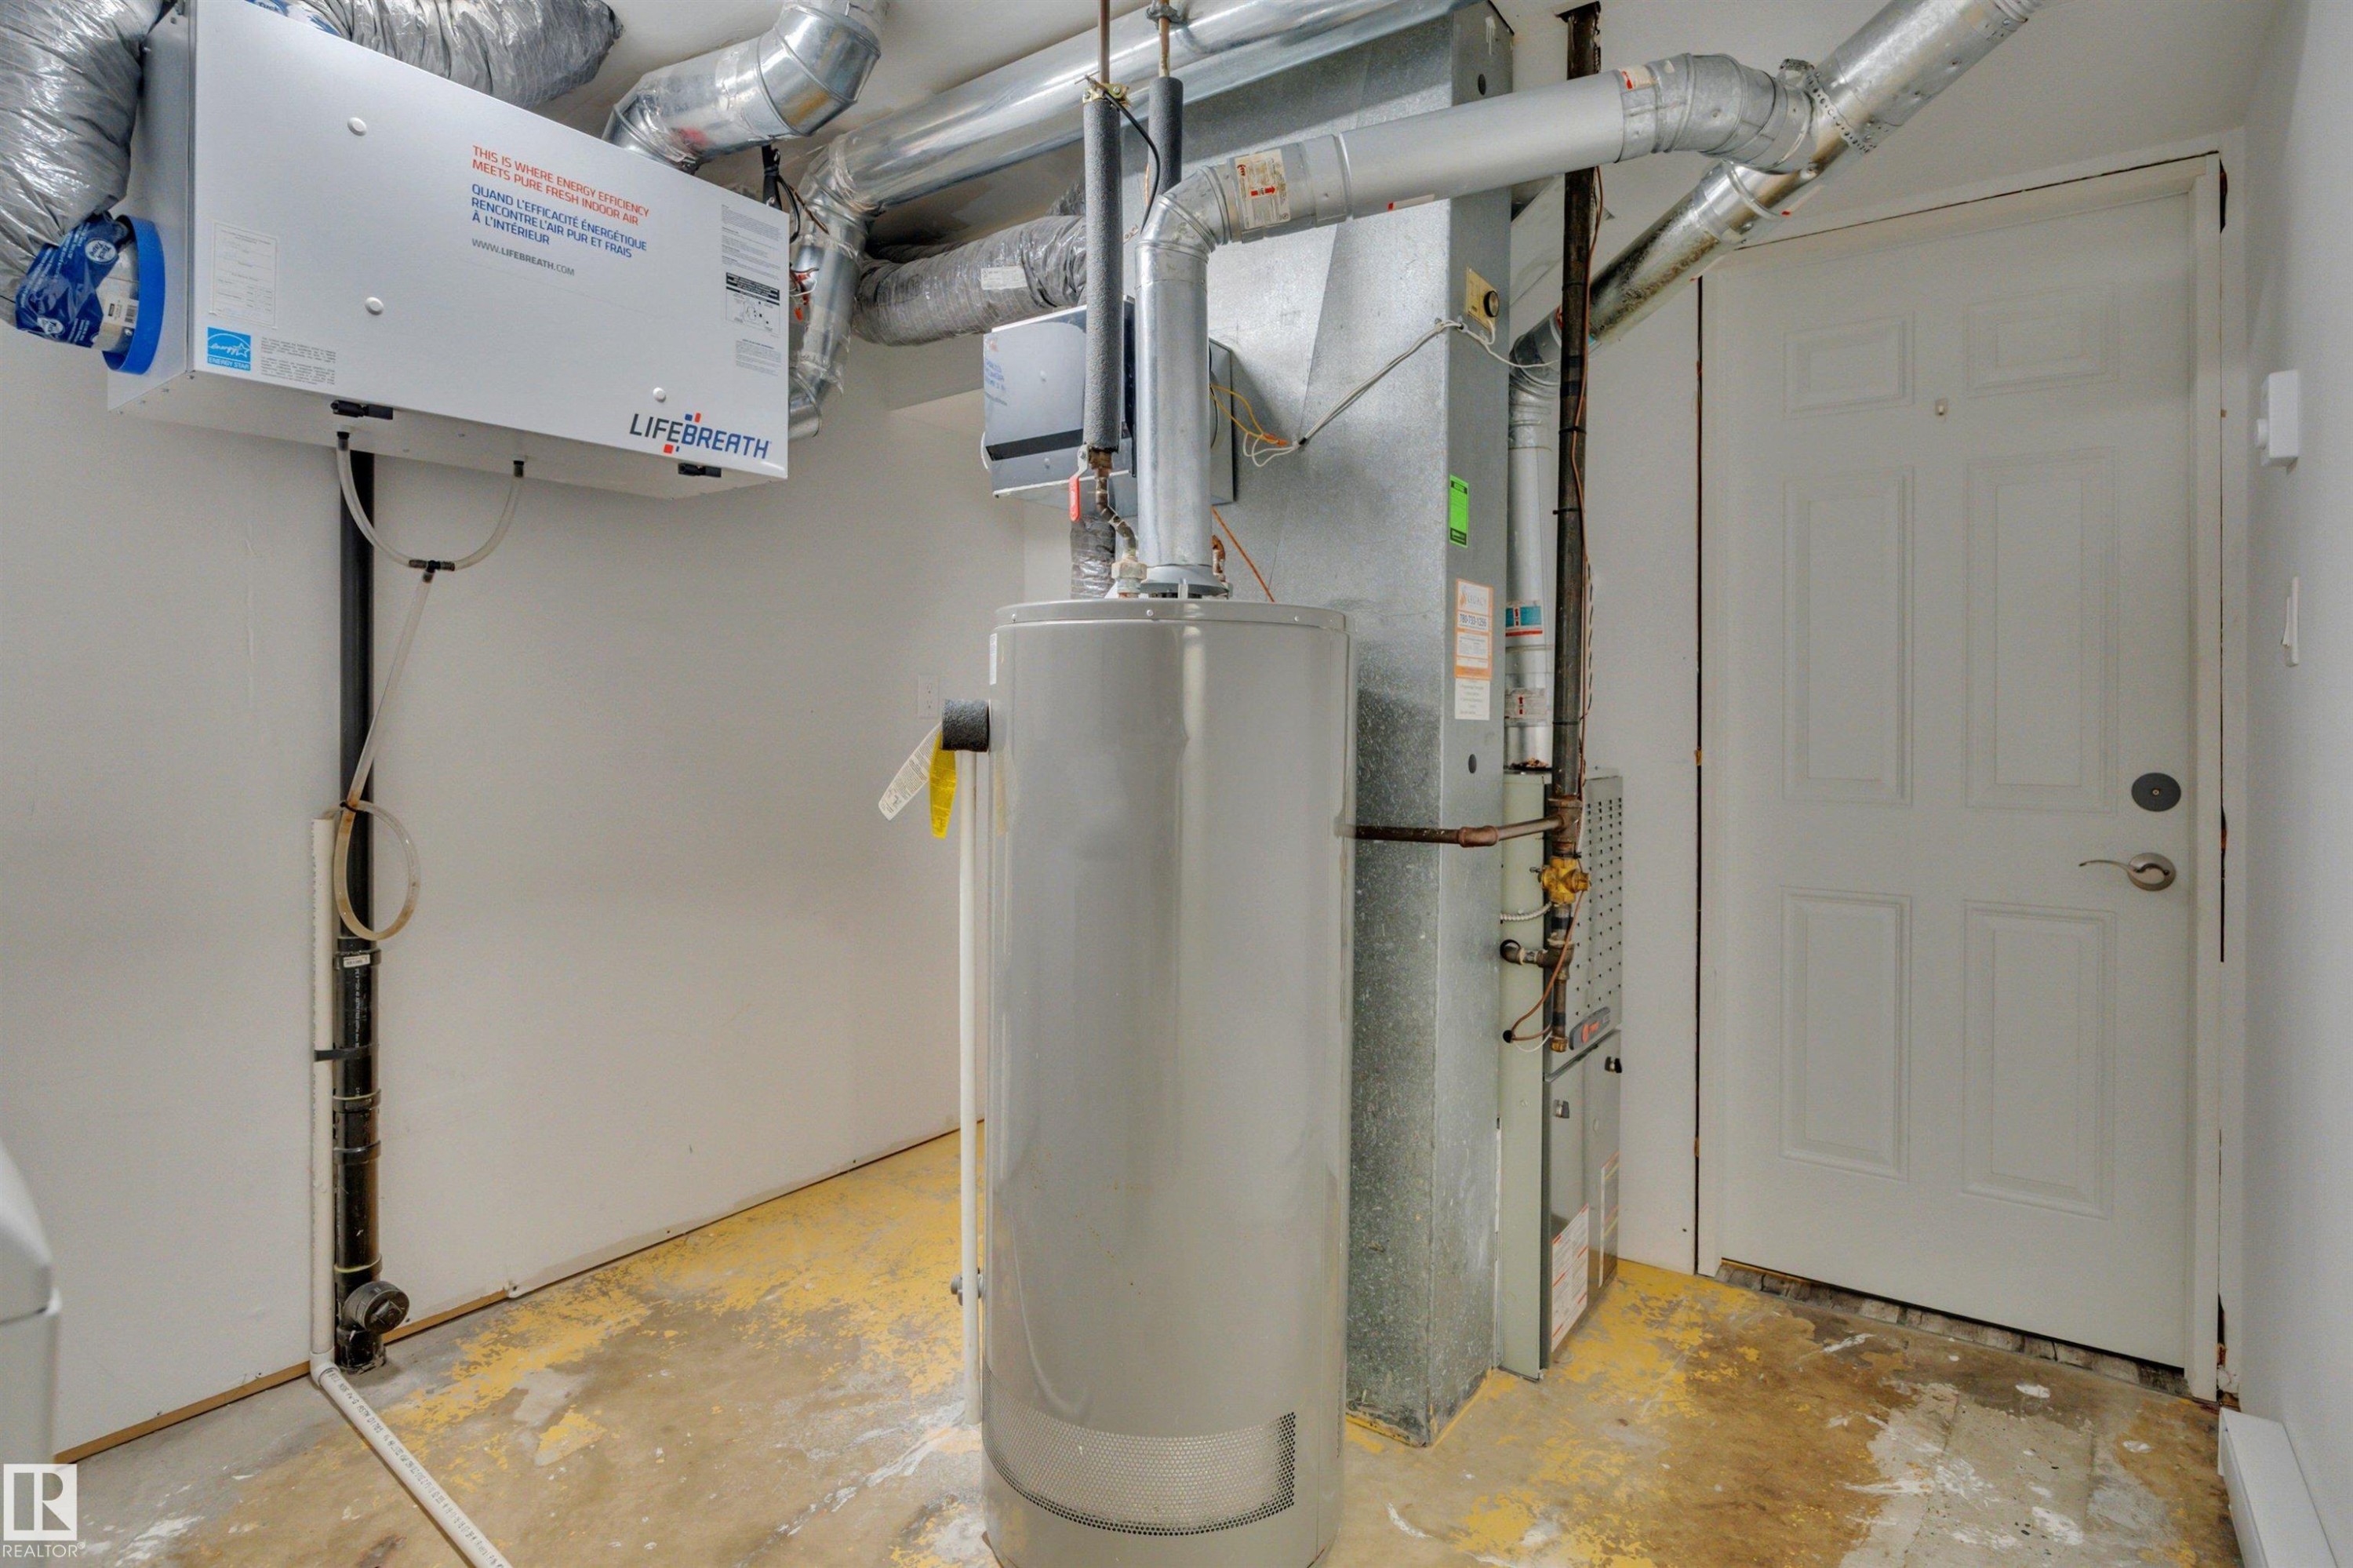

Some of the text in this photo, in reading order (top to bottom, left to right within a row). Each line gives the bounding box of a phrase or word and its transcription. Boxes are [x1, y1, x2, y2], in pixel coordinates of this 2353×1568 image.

[472, 145, 649, 217] THIS IS WHERE ENERGY EFFICIENCY
[472, 159, 639, 226] MEETS PURE FRESH INDOOR AIR
[471, 197, 632, 258] RENCONTRE L'AIR PUR ET FRAIS
[472, 184, 647, 251] QUAND L'EFFICACITÉ ÉNERGÉTIQUE
[472, 209, 550, 245] À L'INTÉRIEUR
[472, 238, 575, 276] WWW.LIFEBREATH.COM
[208, 356, 250, 370] ENERGY STAR
[630, 413, 770, 459] LIFEBREATH
